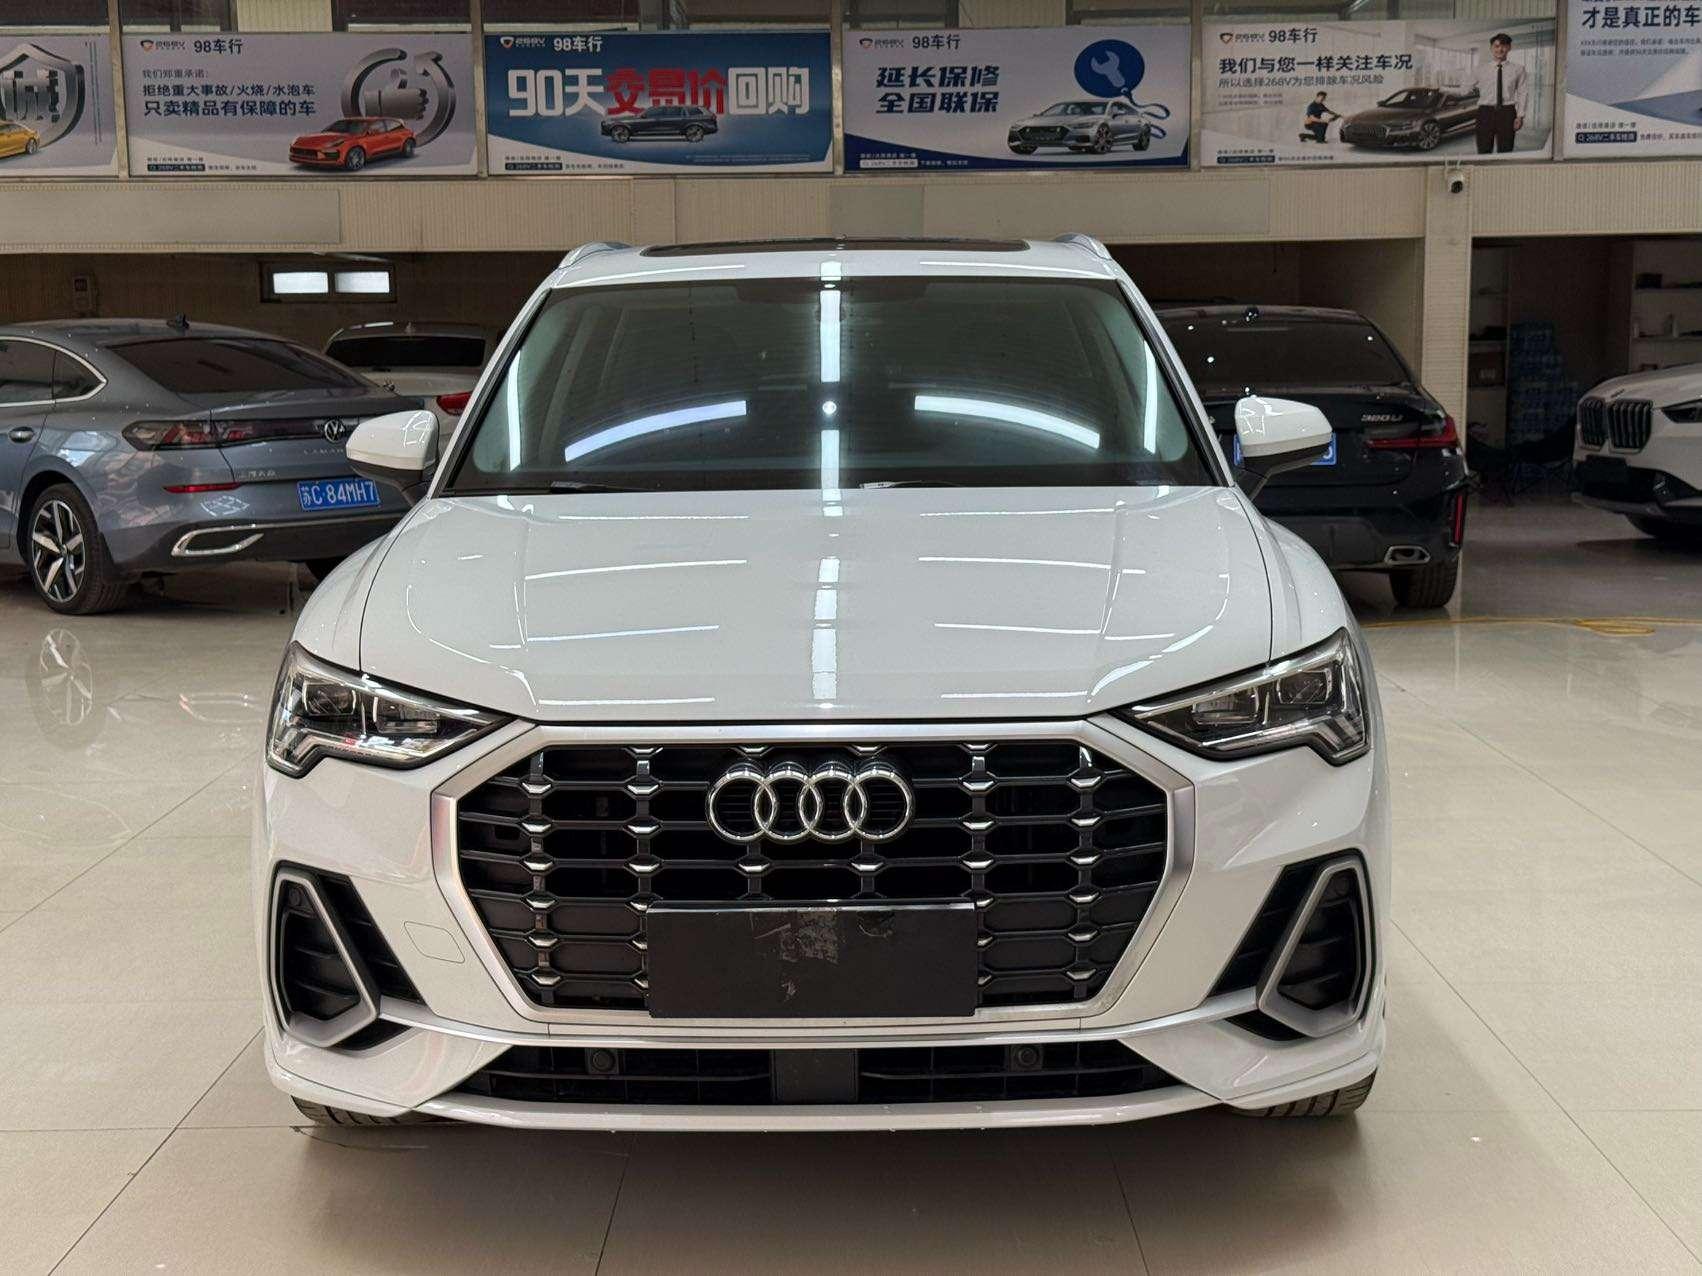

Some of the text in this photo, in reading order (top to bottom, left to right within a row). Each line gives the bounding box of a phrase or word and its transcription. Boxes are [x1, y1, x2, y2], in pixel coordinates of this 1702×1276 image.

[1582, 5, 1702, 29] 才是真正的车
[553, 36, 603, 52] 98车行
[912, 34, 961, 50] 98车行
[1268, 28, 1318, 43] 98车行
[194, 38, 243, 54] 98车行
[1219, 54, 1413, 74] 我们与您一样关注车况
[875, 65, 1000, 88] 延长保修
[143, 84, 316, 97] 拒绝重大事故/火烧/水泡车
[507, 66, 810, 117] 90天交易价回购
[144, 100, 317, 117] 只卖精品有保障的车
[875, 91, 1000, 114] 全国联保
